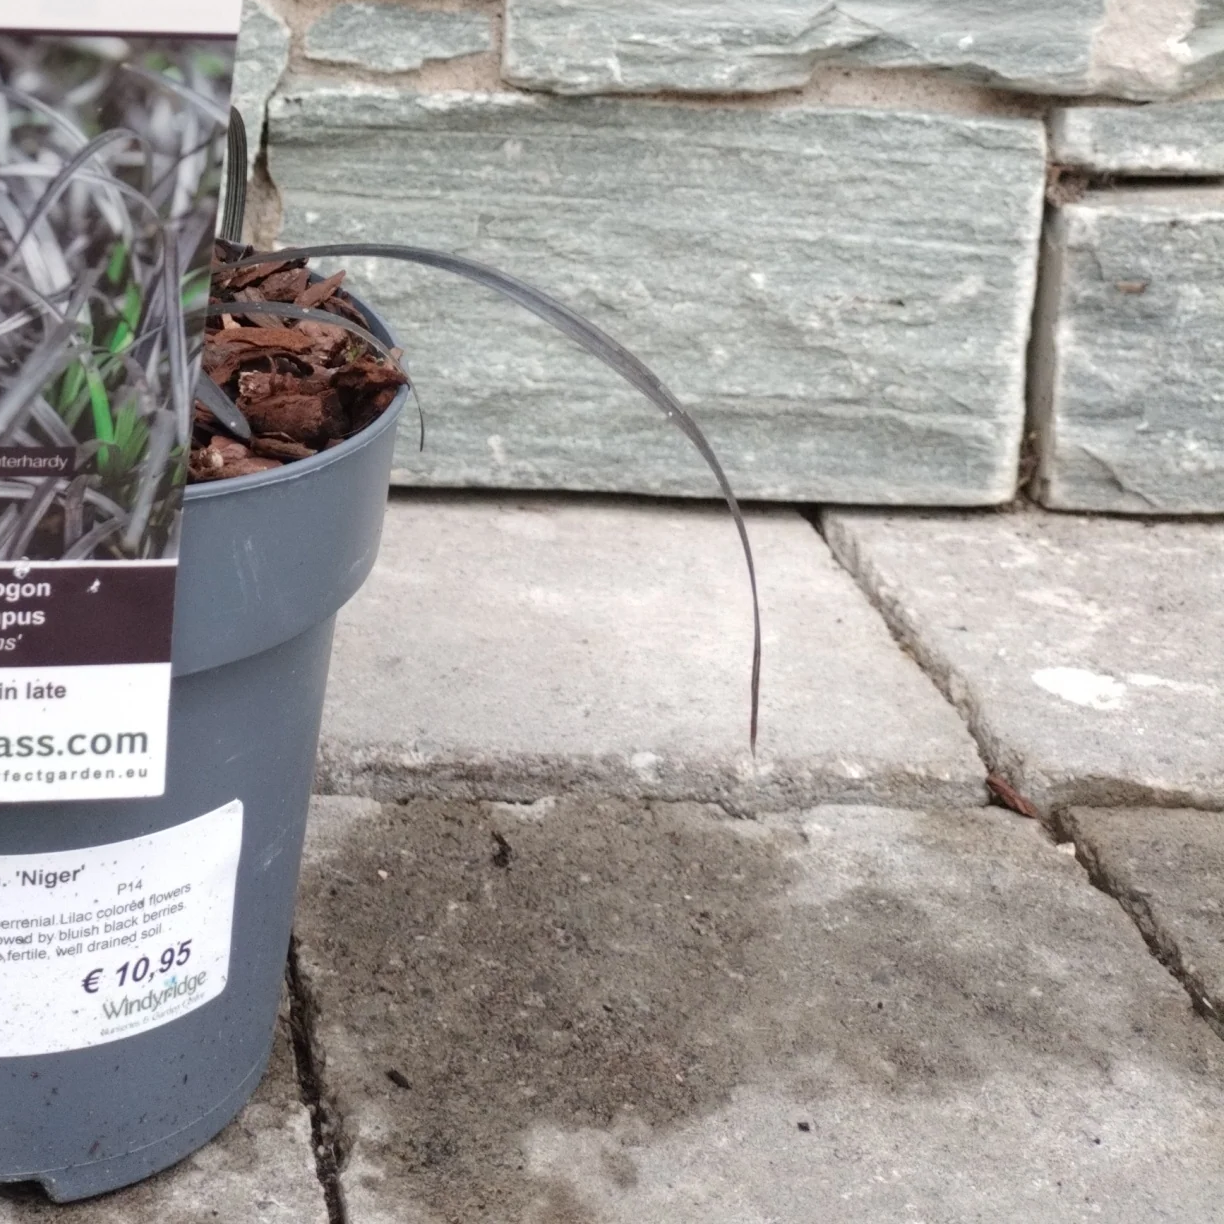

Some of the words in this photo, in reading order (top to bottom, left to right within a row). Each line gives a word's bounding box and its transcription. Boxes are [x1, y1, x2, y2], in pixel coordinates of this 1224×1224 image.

[26, 681, 68, 700] late
[16, 863, 85, 889] 'Niger'
[117, 879, 143, 895] P14
[96, 897, 145, 920] colored
[149, 882, 192, 907] flowers
[38, 931, 55, 945] by
[59, 925, 99, 941] bluish
[104, 915, 139, 933] black
[56, 942, 83, 957] well
[87, 930, 137, 953] drained
[141, 922, 162, 940] soil
[81, 967, 105, 994] €
[115, 938, 193, 988] 10,95
